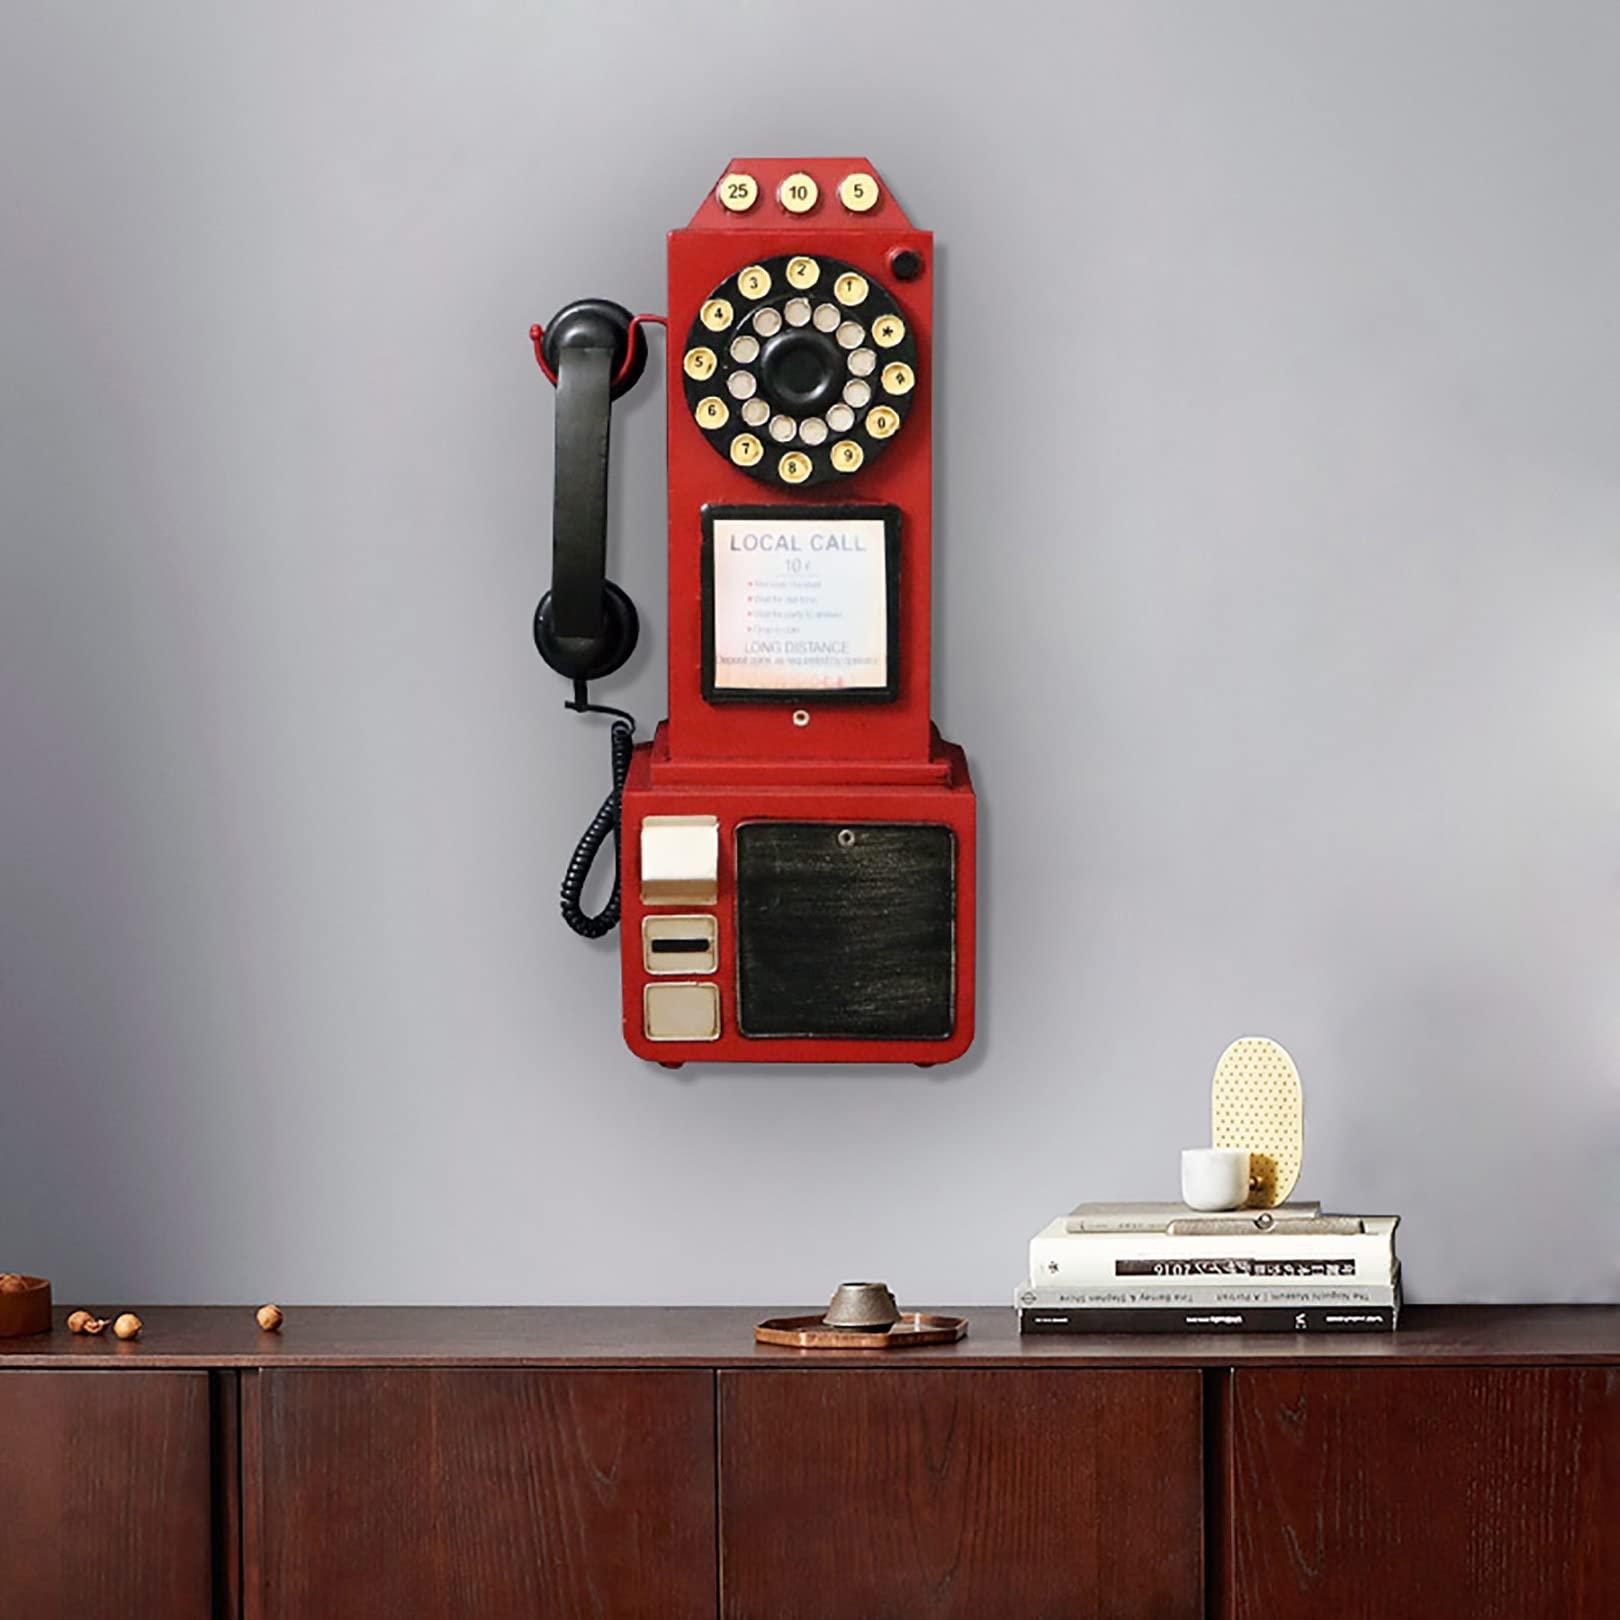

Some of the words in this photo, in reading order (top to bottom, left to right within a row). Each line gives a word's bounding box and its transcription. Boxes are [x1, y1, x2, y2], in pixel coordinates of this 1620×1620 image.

[728, 184, 748, 199] 25
[789, 186, 808, 200] 10
[853, 184, 864, 198] 5
[797, 264, 806, 276] 2
[750, 277, 759, 289] 3
[846, 281, 852, 292] 1
[714, 308, 724, 319] 4
[695, 355, 703, 367] 5
[708, 405, 716, 417] 6
[877, 416, 886, 429] 0
[742, 443, 750, 455] 7
[844, 450, 853, 462] 9
[788, 462, 797, 474] 8
[730, 534, 802, 552] LOCAL
[810, 534, 867, 552] CALL
[785, 558, 801, 573] 10
[744, 640, 781, 655] LONG
[785, 640, 850, 655] DISTANCE
